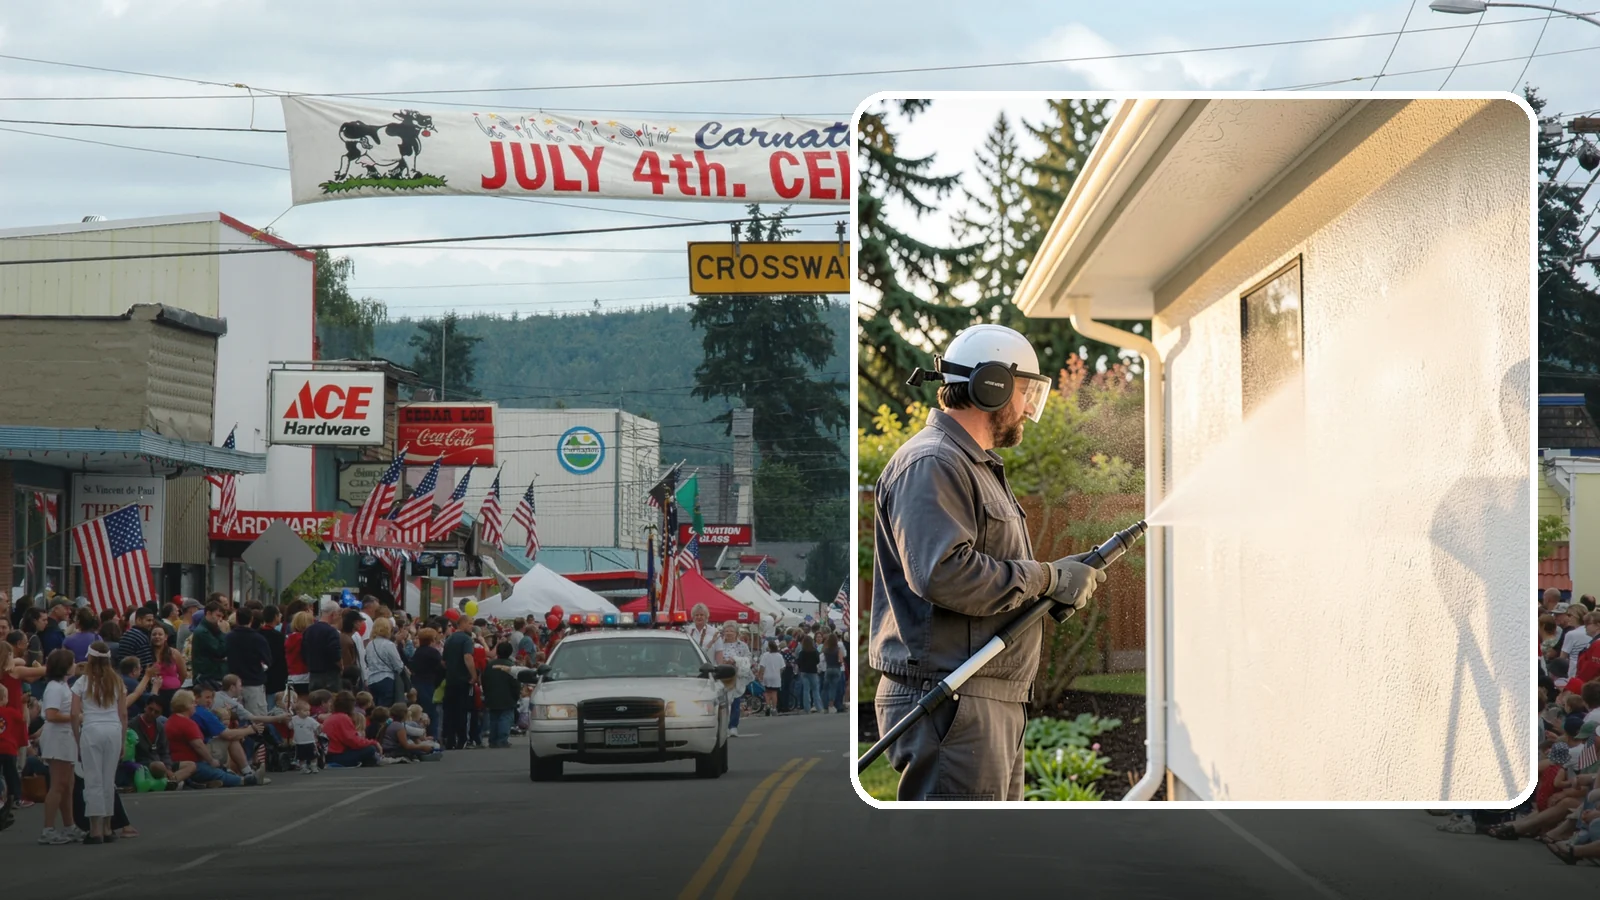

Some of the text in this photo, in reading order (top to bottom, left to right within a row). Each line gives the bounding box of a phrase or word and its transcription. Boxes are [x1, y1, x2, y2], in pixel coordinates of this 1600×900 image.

[695, 121, 850, 150] Carnat
[481, 140, 605, 192] JULY
[632, 149, 746, 198] 4th.
[697, 254, 850, 280] CROSSWA
[282, 380, 374, 420] ACE
[406, 409, 452, 421] CEDAR
[283, 420, 371, 437] Hardware
[416, 428, 477, 447] Coca-Cola
[354, 467, 385, 481] Simpl
[95, 485, 125, 494] Vincent
[126, 486, 136, 495] de
[137, 486, 155, 495] Paul
[212, 516, 331, 536] HARDARE
[688, 526, 741, 535] CRNATION
[699, 535, 730, 543] GLASS
